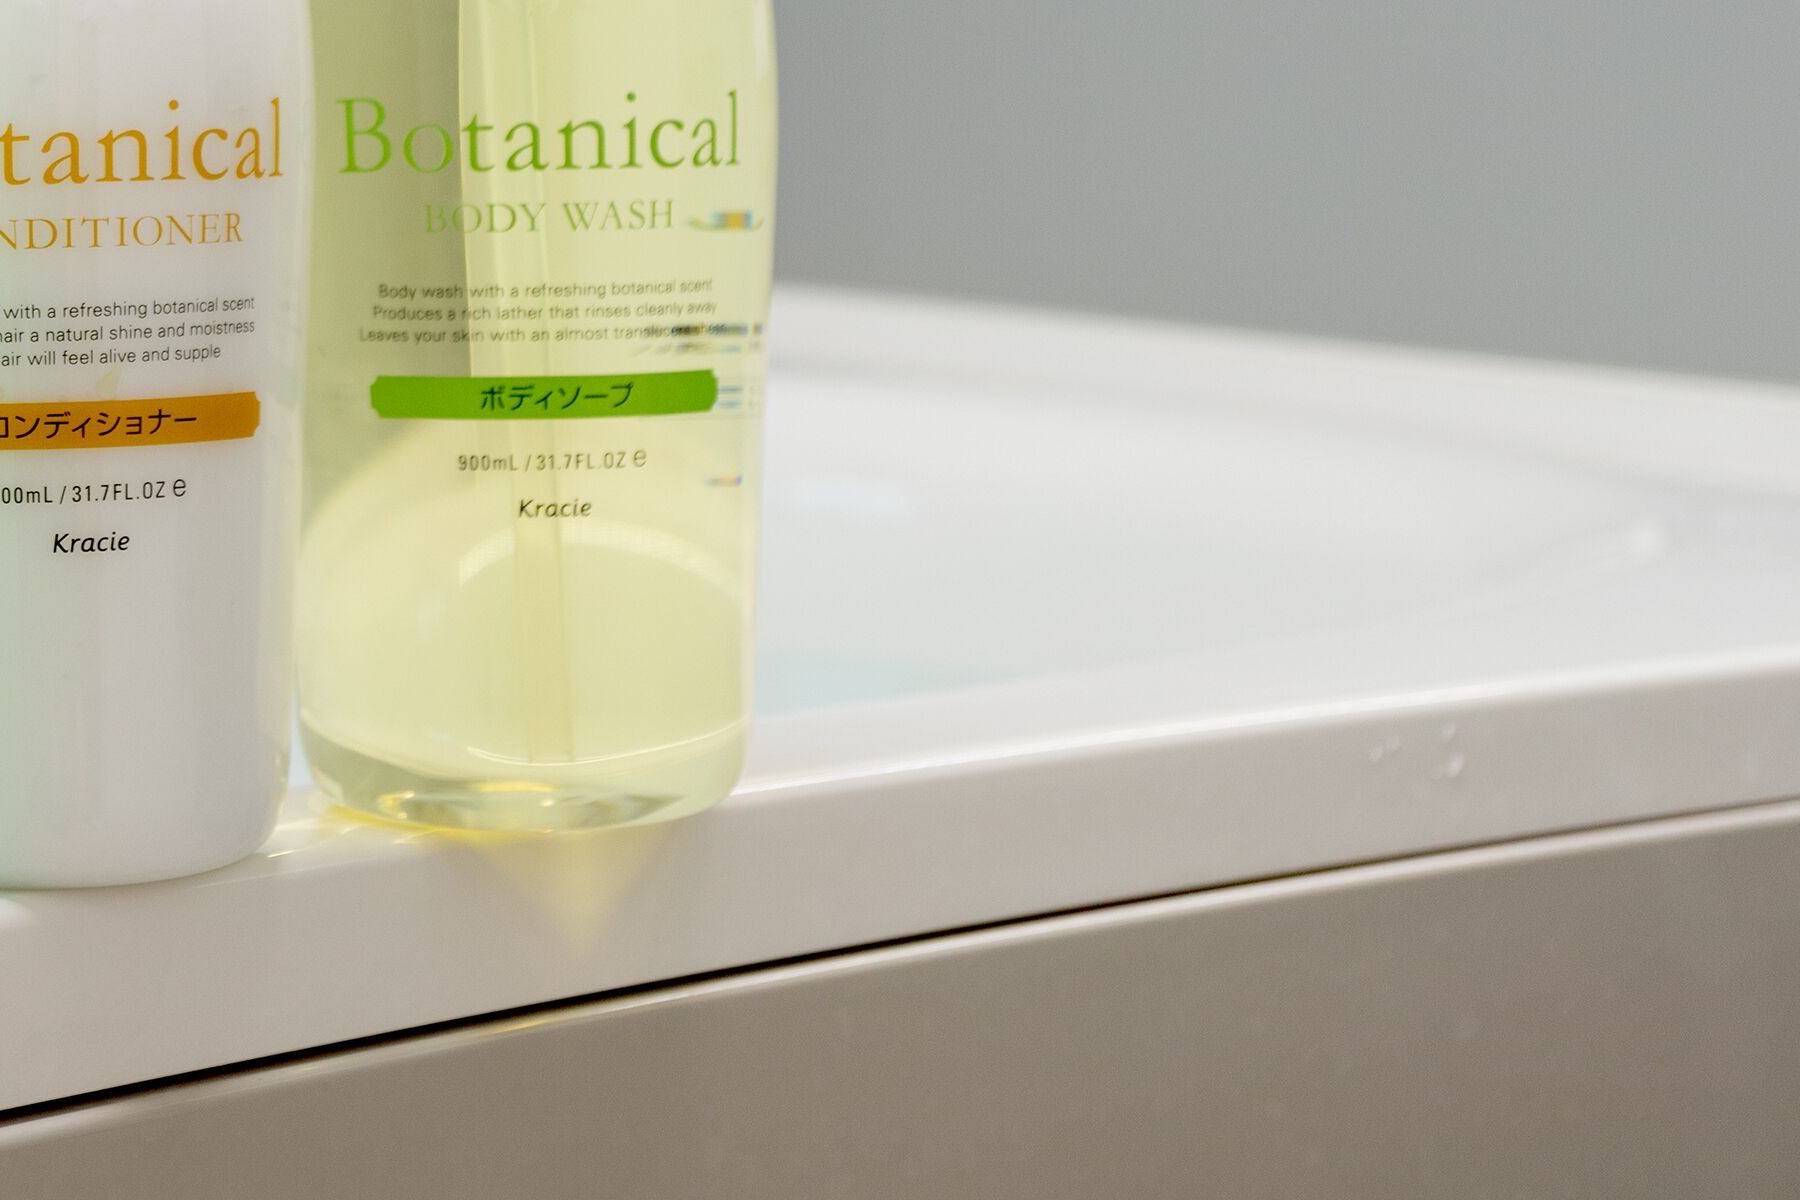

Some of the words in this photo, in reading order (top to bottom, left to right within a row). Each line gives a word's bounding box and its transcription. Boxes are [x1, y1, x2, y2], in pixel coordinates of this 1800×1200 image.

[335, 89, 739, 174] Botanical
[424, 203, 546, 234] BODY
[563, 199, 674, 232] WASH
[379, 284, 415, 300] Body
[422, 284, 463, 299] wash
[470, 284, 504, 297] with
[511, 287, 519, 297] a
[526, 283, 606, 300] refreshing
[611, 281, 676, 296] botanical
[680, 278, 713, 293] scent
[3, 304, 40, 319] with
[48, 307, 56, 318] a
[63, 302, 148, 320] refreshing
[153, 299, 218, 315] botanical
[223, 297, 254, 311] scent
[373, 306, 442, 320] Produces
[448, 309, 456, 319] a
[462, 306, 491, 319] rich
[498, 305, 542, 320] lather
[550, 304, 579, 319] that
[585, 303, 631, 318] rinses
[636, 302, 683, 318] cleanly
[687, 302, 718, 316] away
[30, 332, 39, 343] a
[46, 326, 103, 342] natural
[110, 324, 152, 340] shine
[158, 322, 184, 338] and
[190, 320, 254, 336] moistness
[360, 328, 409, 342] Leaves
[414, 331, 446, 345] your
[453, 327, 484, 342] skin
[491, 327, 525, 341] with
[531, 330, 549, 341] an
[555, 326, 608, 341] almost
[27, 350, 56, 365] will
[63, 349, 93, 365] feel
[100, 348, 136, 363] alive
[142, 347, 169, 362] and
[175, 345, 221, 361] supple
[481, 381, 634, 411] ボディソープ
[518, 498, 592, 518] Kracie
[53, 532, 129, 553] Kracie
